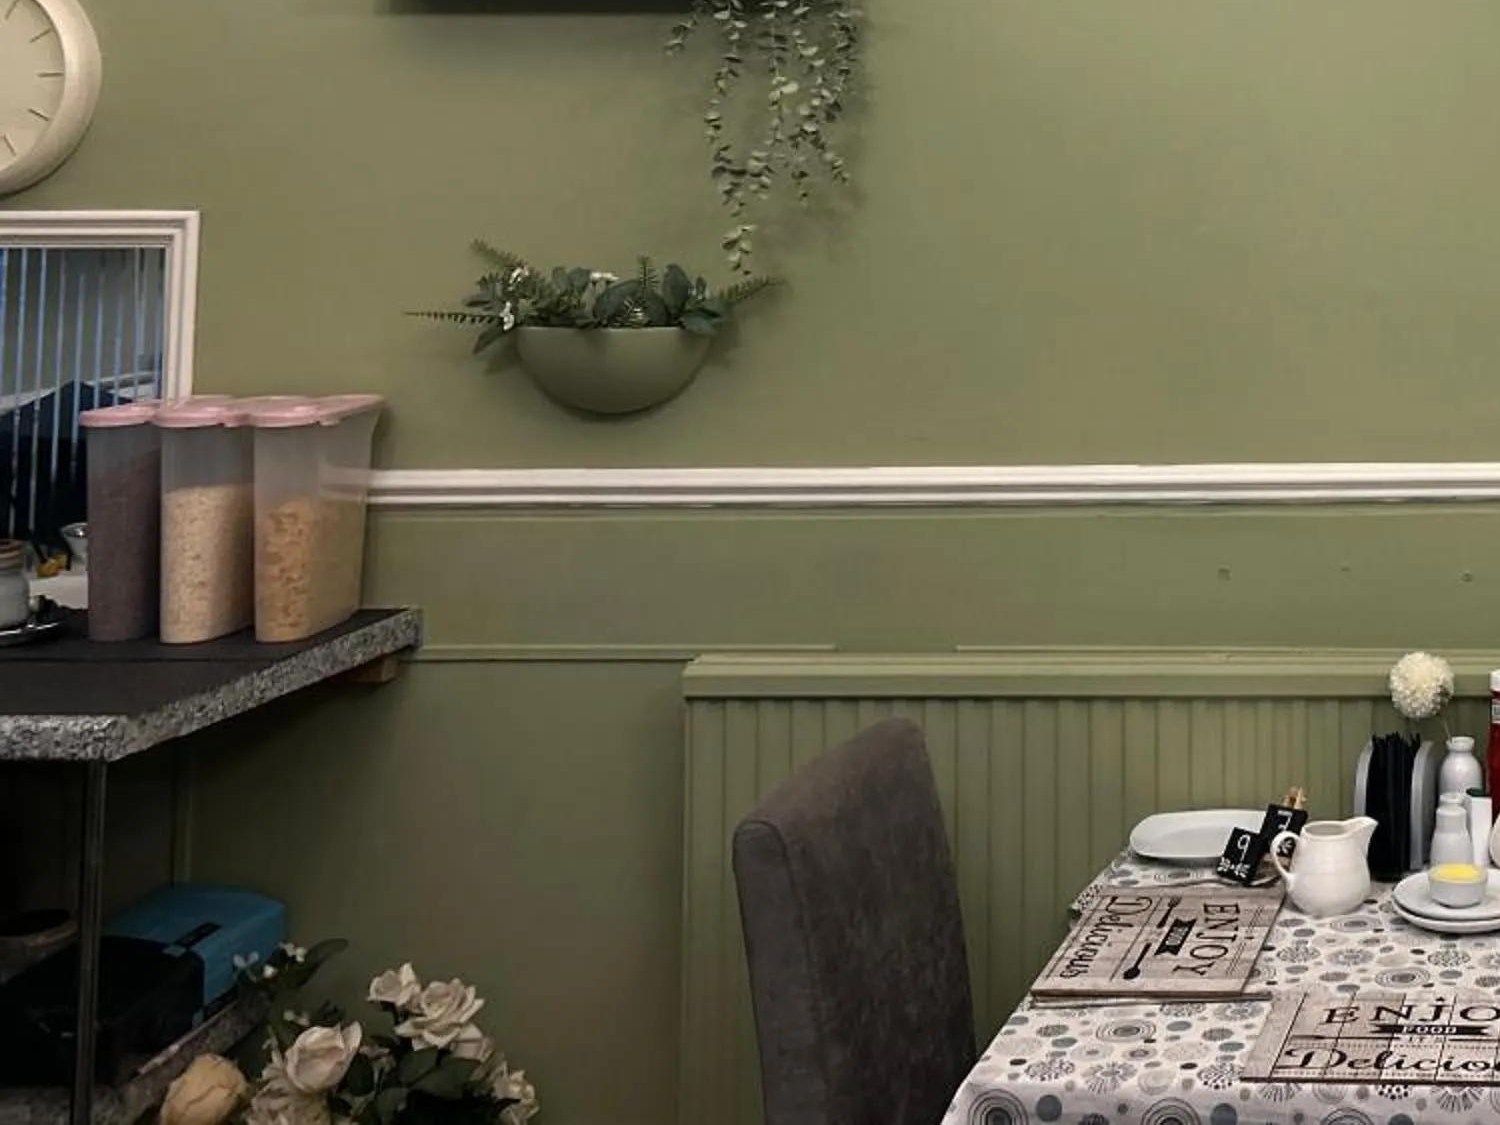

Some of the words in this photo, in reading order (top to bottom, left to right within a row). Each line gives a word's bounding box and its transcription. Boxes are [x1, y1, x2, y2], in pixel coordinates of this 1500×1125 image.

[1237, 834, 1251, 863] 9
[1059, 896, 1153, 979] Delicious
[1173, 902, 1240, 976] ENJOY
[1401, 1025, 1457, 1034] FOOD
